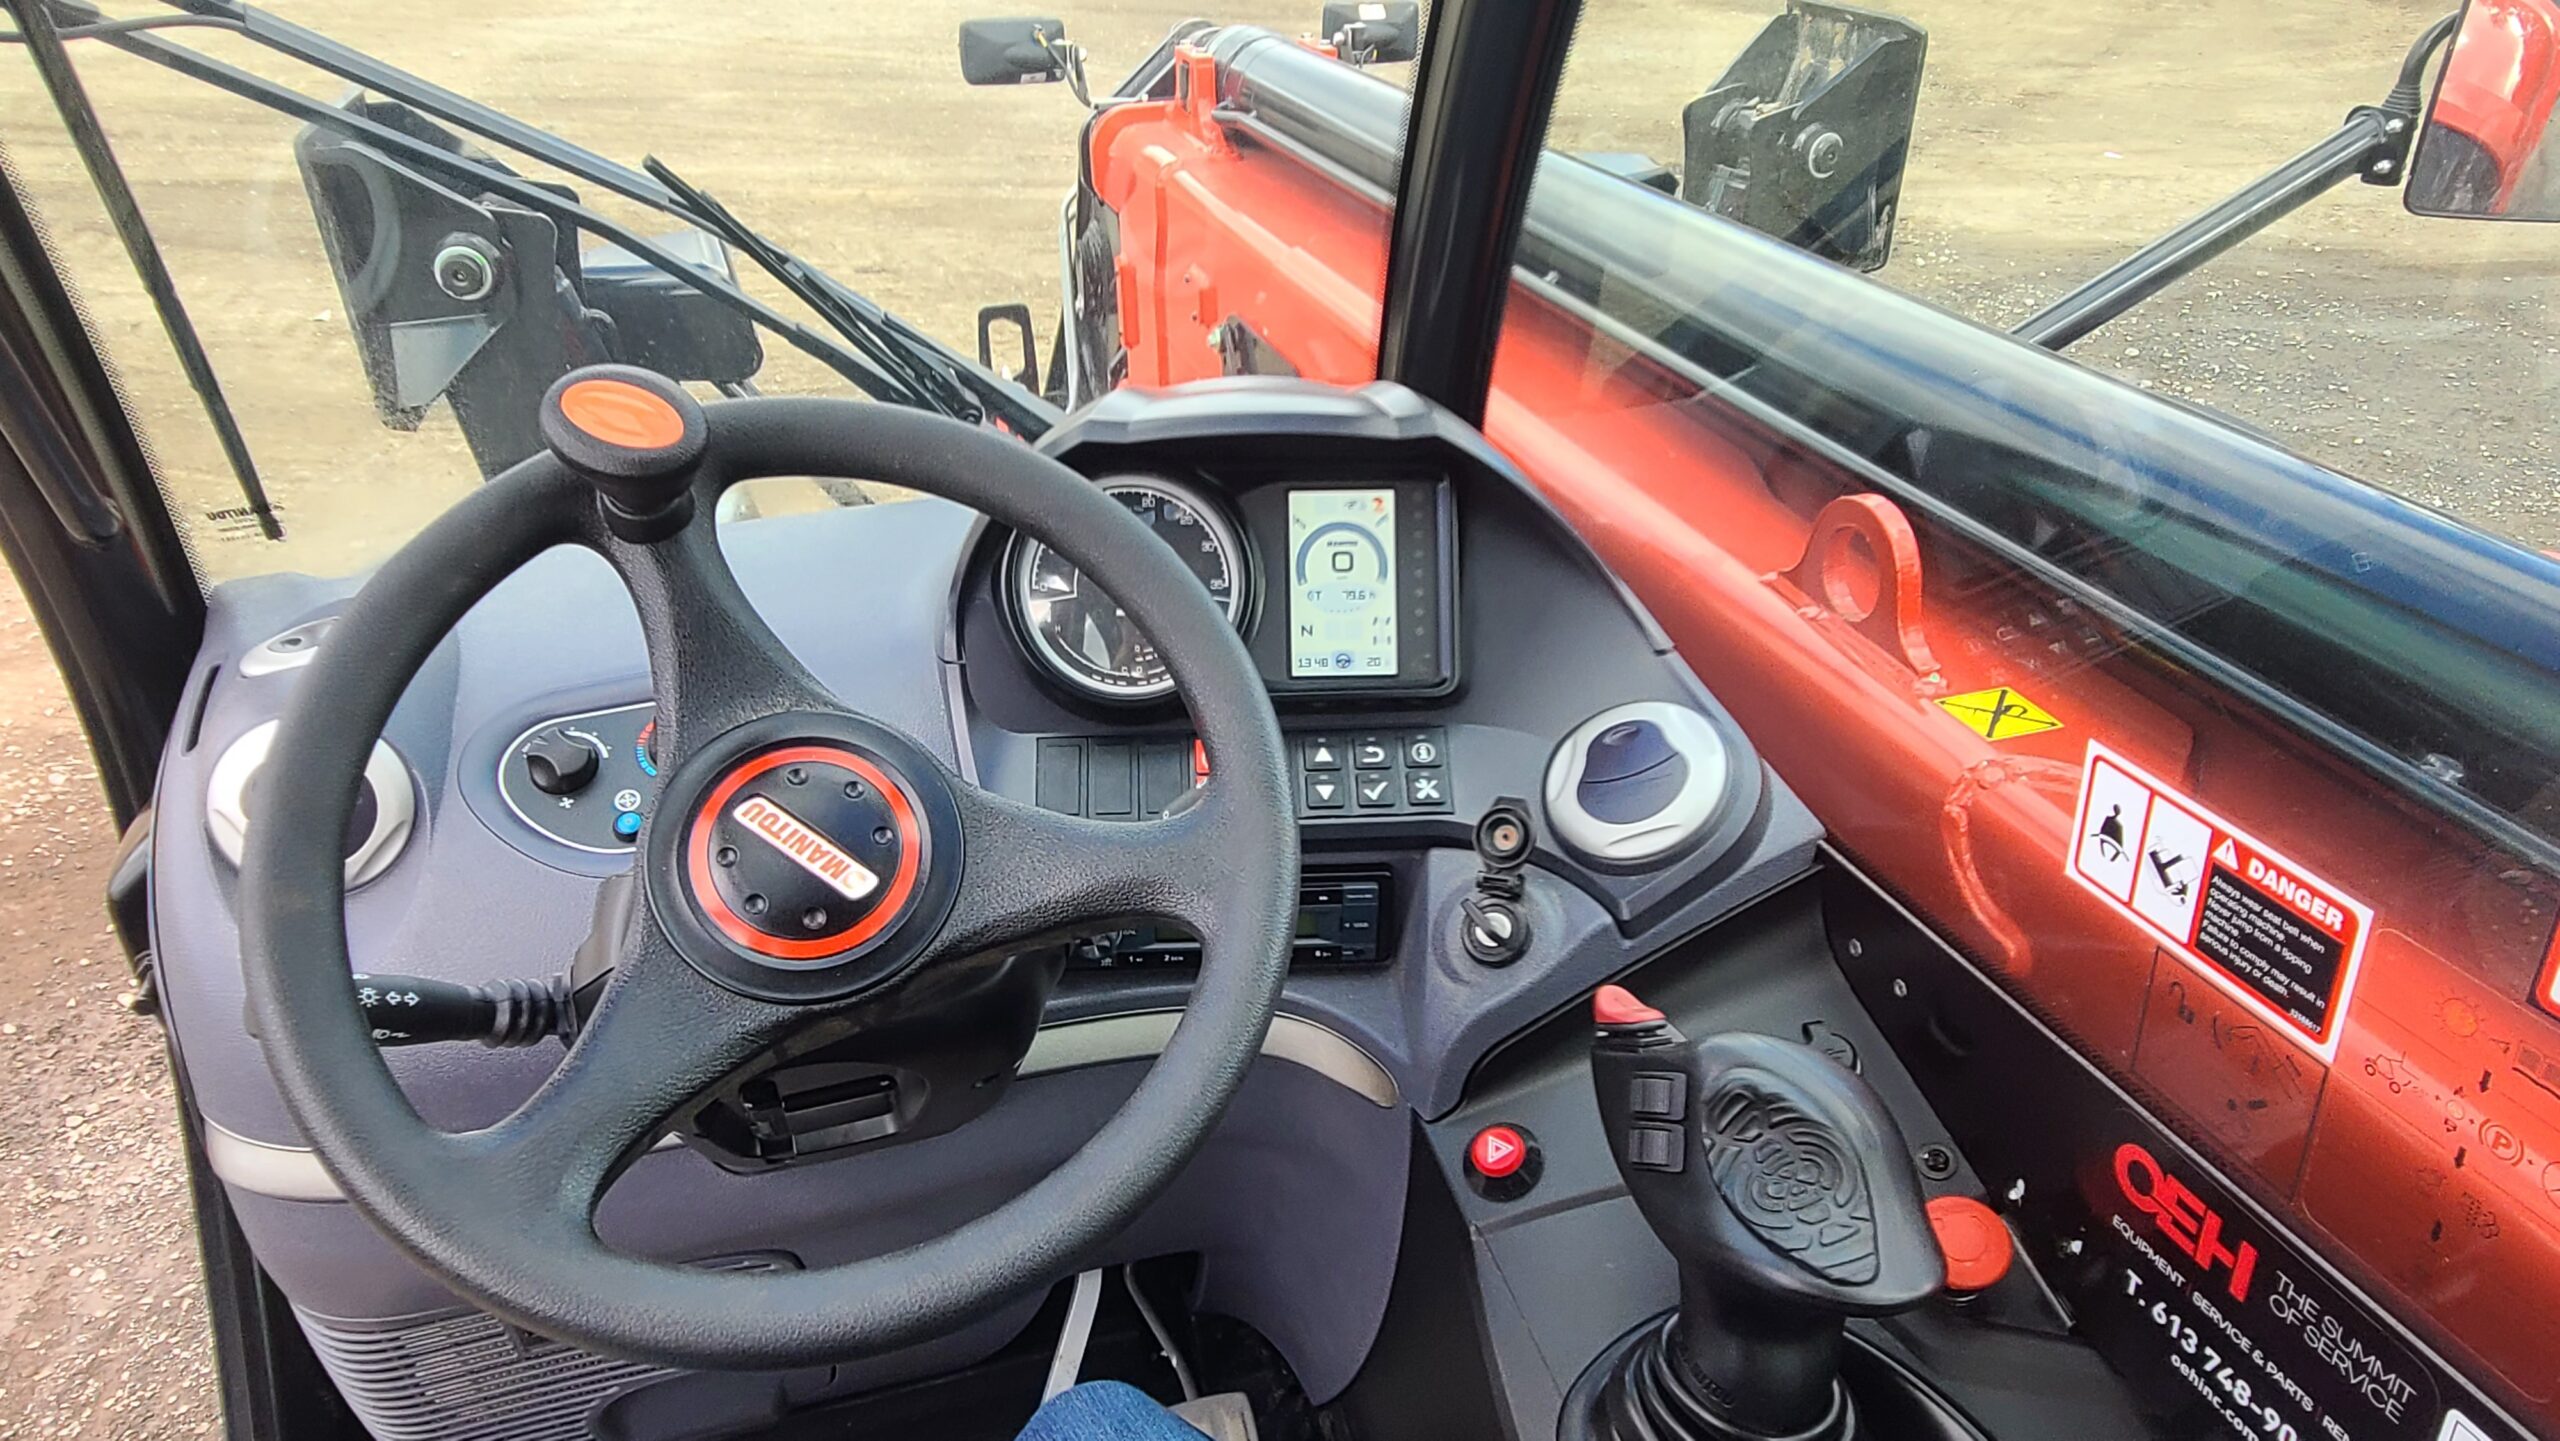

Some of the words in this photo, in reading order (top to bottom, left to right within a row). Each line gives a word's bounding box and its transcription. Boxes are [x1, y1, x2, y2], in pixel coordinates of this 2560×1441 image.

[1202, 541, 1214, 552] 30
[1210, 579, 1223, 590] 35
[1301, 625, 1313, 637] N
[742, 802, 851, 880] MANITOU
[2205, 910, 2240, 938] machine.
[2207, 897, 2232, 917] Never
[2231, 914, 2253, 933] jump
[2254, 928, 2273, 946] from
[2210, 888, 2248, 918] operating
[2248, 914, 2285, 942] machine.
[2211, 876, 2241, 899] Always
[2242, 896, 2263, 912] wear
[2263, 909, 2282, 925] seat
[2283, 920, 2299, 937] belt
[2300, 934, 2324, 953] when
[2248, 857, 2345, 932] DANGER
[2200, 932, 2228, 955] serious
[2229, 952, 2252, 972] injury
[2263, 976, 2288, 997] death.
[2202, 919, 2229, 943] Failure
[2239, 947, 2270, 972] comply
[2271, 968, 2290, 985] may
[2290, 982, 2316, 1002] result
[2112, 1213, 2187, 1288] EQUIPMENT
[2192, 1291, 2253, 1354] SERVICE
[2251, 1349, 2266, 1367] &
[2265, 1361, 2315, 1412] PARTS
[2151, 1304, 2198, 1354] 613
[2275, 1270, 2321, 1323] THE
[2321, 1315, 2418, 1404] SUMMIT
[2269, 1294, 2305, 1326] OF
[2303, 1325, 2405, 1425] SERVICE
[2170, 1353, 2261, 1441] oehinc.com
